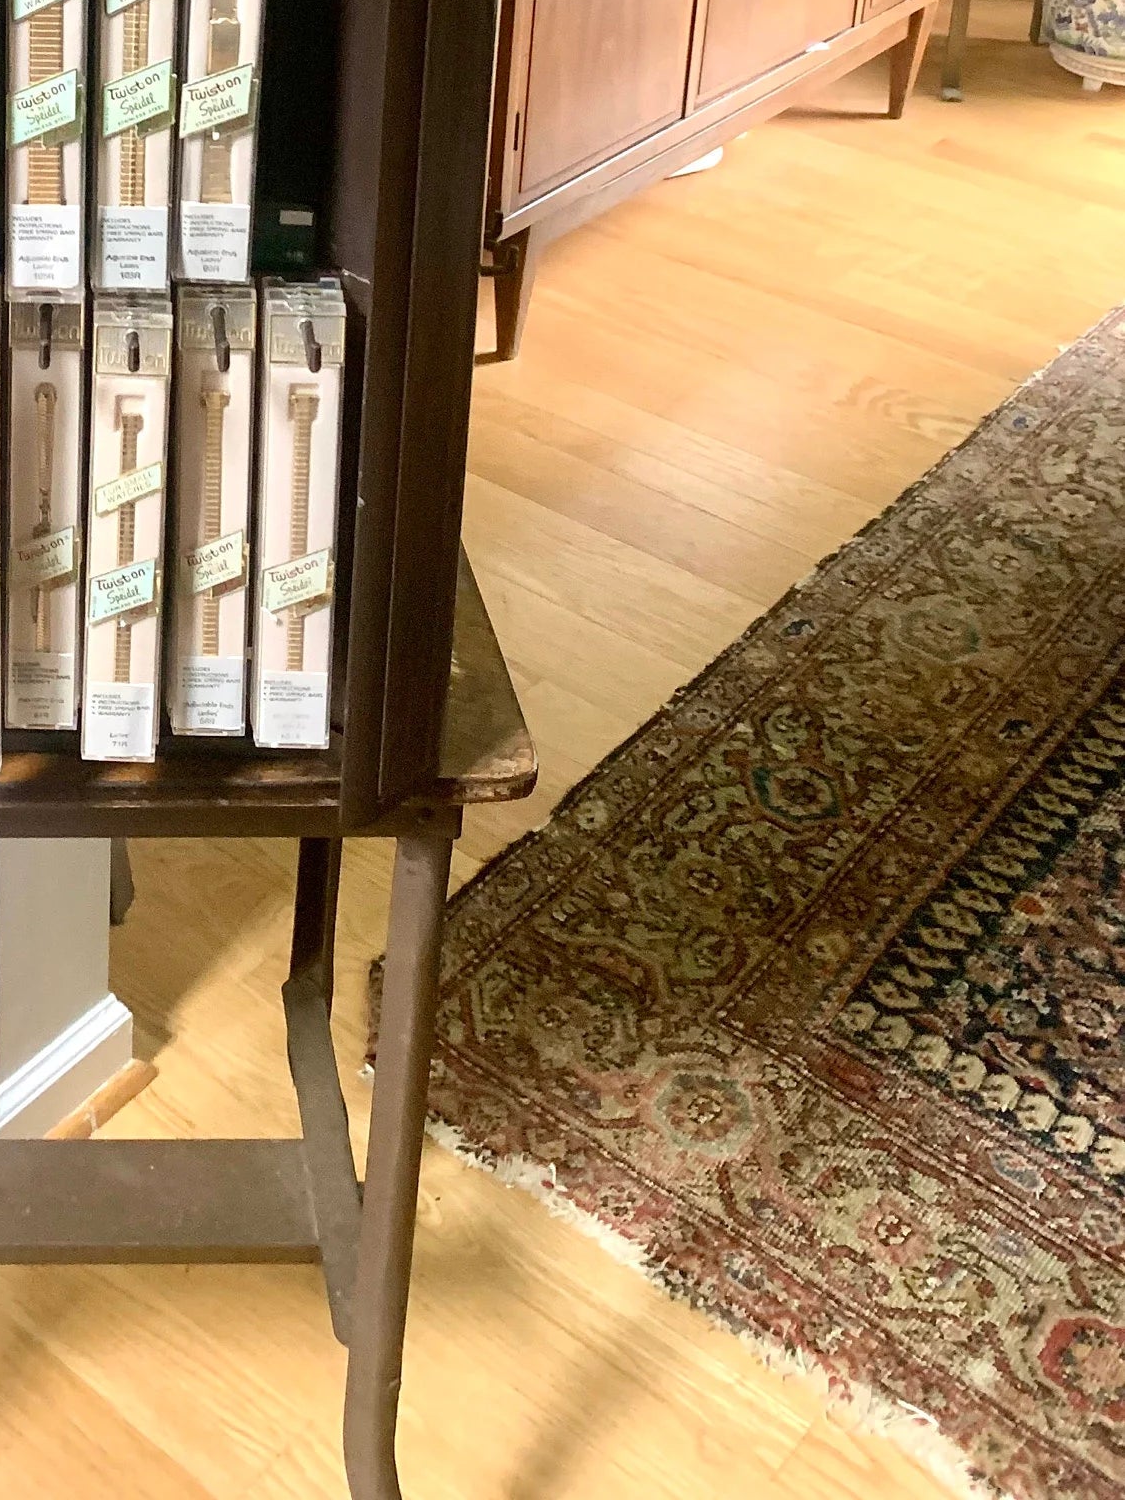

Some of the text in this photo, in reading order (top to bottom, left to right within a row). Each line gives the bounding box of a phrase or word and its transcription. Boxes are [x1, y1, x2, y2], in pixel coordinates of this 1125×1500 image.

[120, 92, 156, 116] Speidel
[198, 95, 236, 117] Speidel
[106, 584, 141, 606] Speidel
